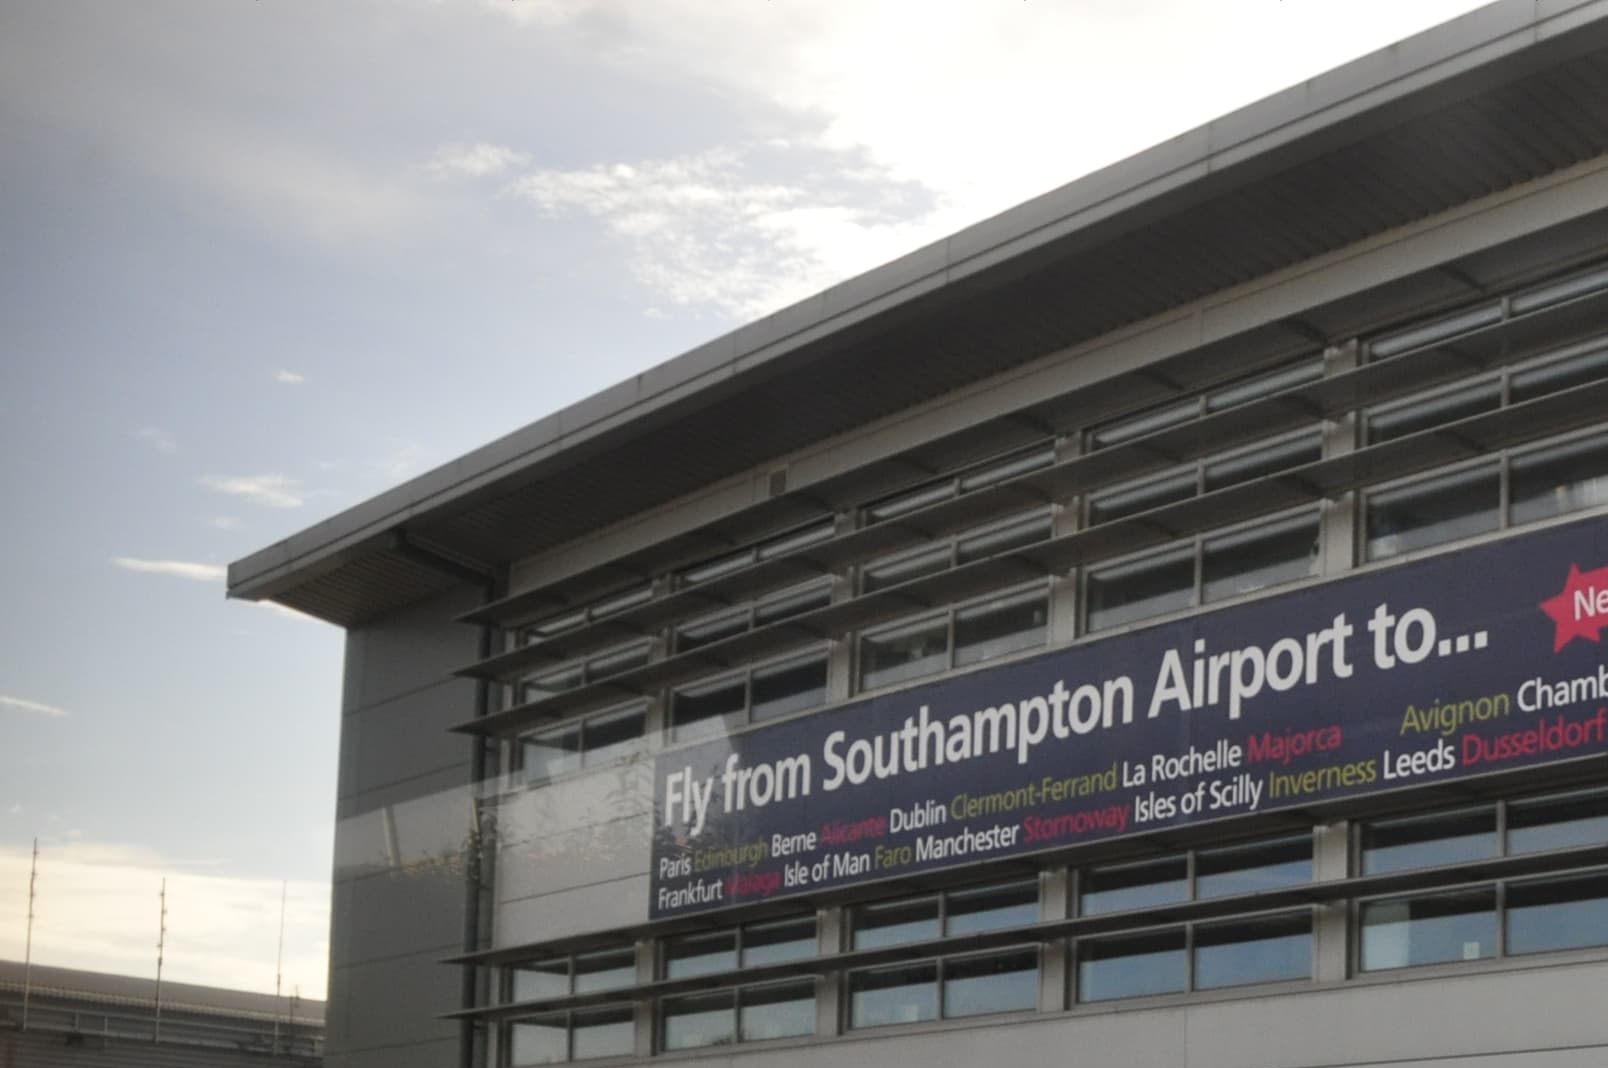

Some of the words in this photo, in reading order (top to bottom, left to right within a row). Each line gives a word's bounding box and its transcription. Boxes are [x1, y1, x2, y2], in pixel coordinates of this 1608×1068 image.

[658, 878, 724, 910] Frankfurt
[784, 861, 809, 887] Isle
[811, 854, 830, 882] of
[833, 851, 871, 878] Man
[875, 845, 912, 869] Faro
[916, 824, 1020, 863] Manchester
[1134, 788, 1176, 823] Isles
[1180, 787, 1206, 816] of
[1210, 773, 1263, 811] Scilly
[1269, 757, 1377, 800] Inverness
[1383, 738, 1456, 780] Leeds
[1462, 709, 1607, 766] Dusseldorf
[659, 852, 691, 880] Paris
[771, 831, 817, 858] Berne
[889, 800, 947, 834] Dublin
[950, 766, 1118, 820] Clermont-Ferrand
[1122, 754, 1146, 788] La
[1151, 739, 1243, 781] Rochelle
[1247, 724, 1343, 767] Majorca
[1400, 689, 1510, 737] Avignon
[664, 766, 714, 837] Fly
[721, 753, 811, 813] from
[822, 676, 1134, 792] Southampton
[1147, 612, 1353, 720] Airport
[1368, 603, 1489, 671] to...
